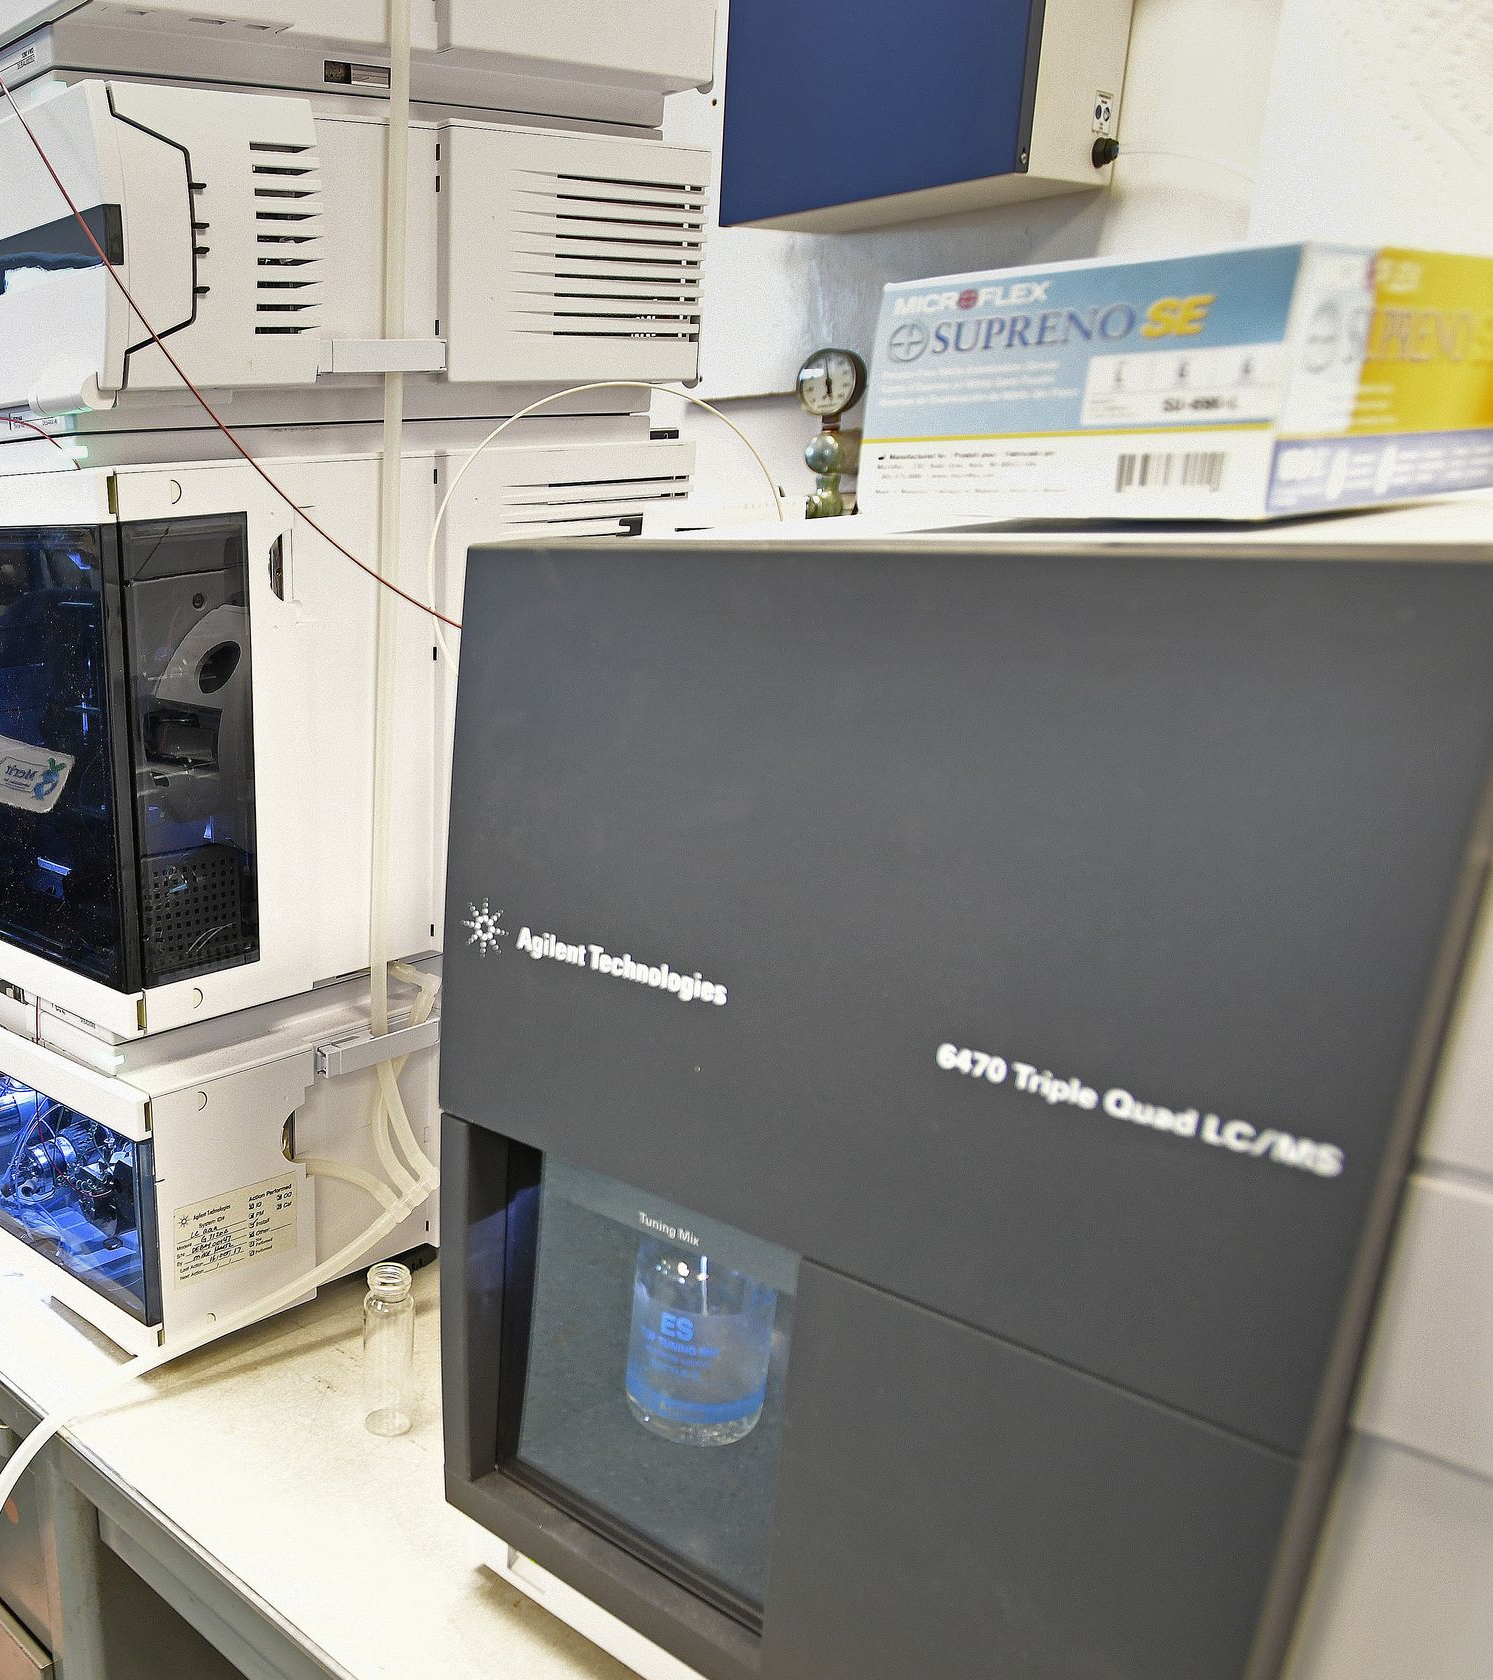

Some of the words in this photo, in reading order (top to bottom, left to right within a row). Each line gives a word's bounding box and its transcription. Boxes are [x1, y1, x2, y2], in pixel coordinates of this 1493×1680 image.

[894, 280, 1052, 316] MICROFLEX
[931, 303, 1138, 357] SUPRENO
[1141, 293, 1217, 339] SE
[515, 926, 587, 967] Agilent
[588, 943, 729, 1006] Technologies
[936, 1042, 1008, 1084] 6470
[1011, 1060, 1099, 1110] Triple
[1102, 1087, 1200, 1138] Quad
[1200, 1112, 1346, 1179] LC/MS
[248, 1193, 266, 1202] Action
[266, 1183, 292, 1197] Performed
[638, 1209, 677, 1240] Tuning
[677, 1226, 700, 1247] Mix
[660, 1311, 694, 1342] ES
